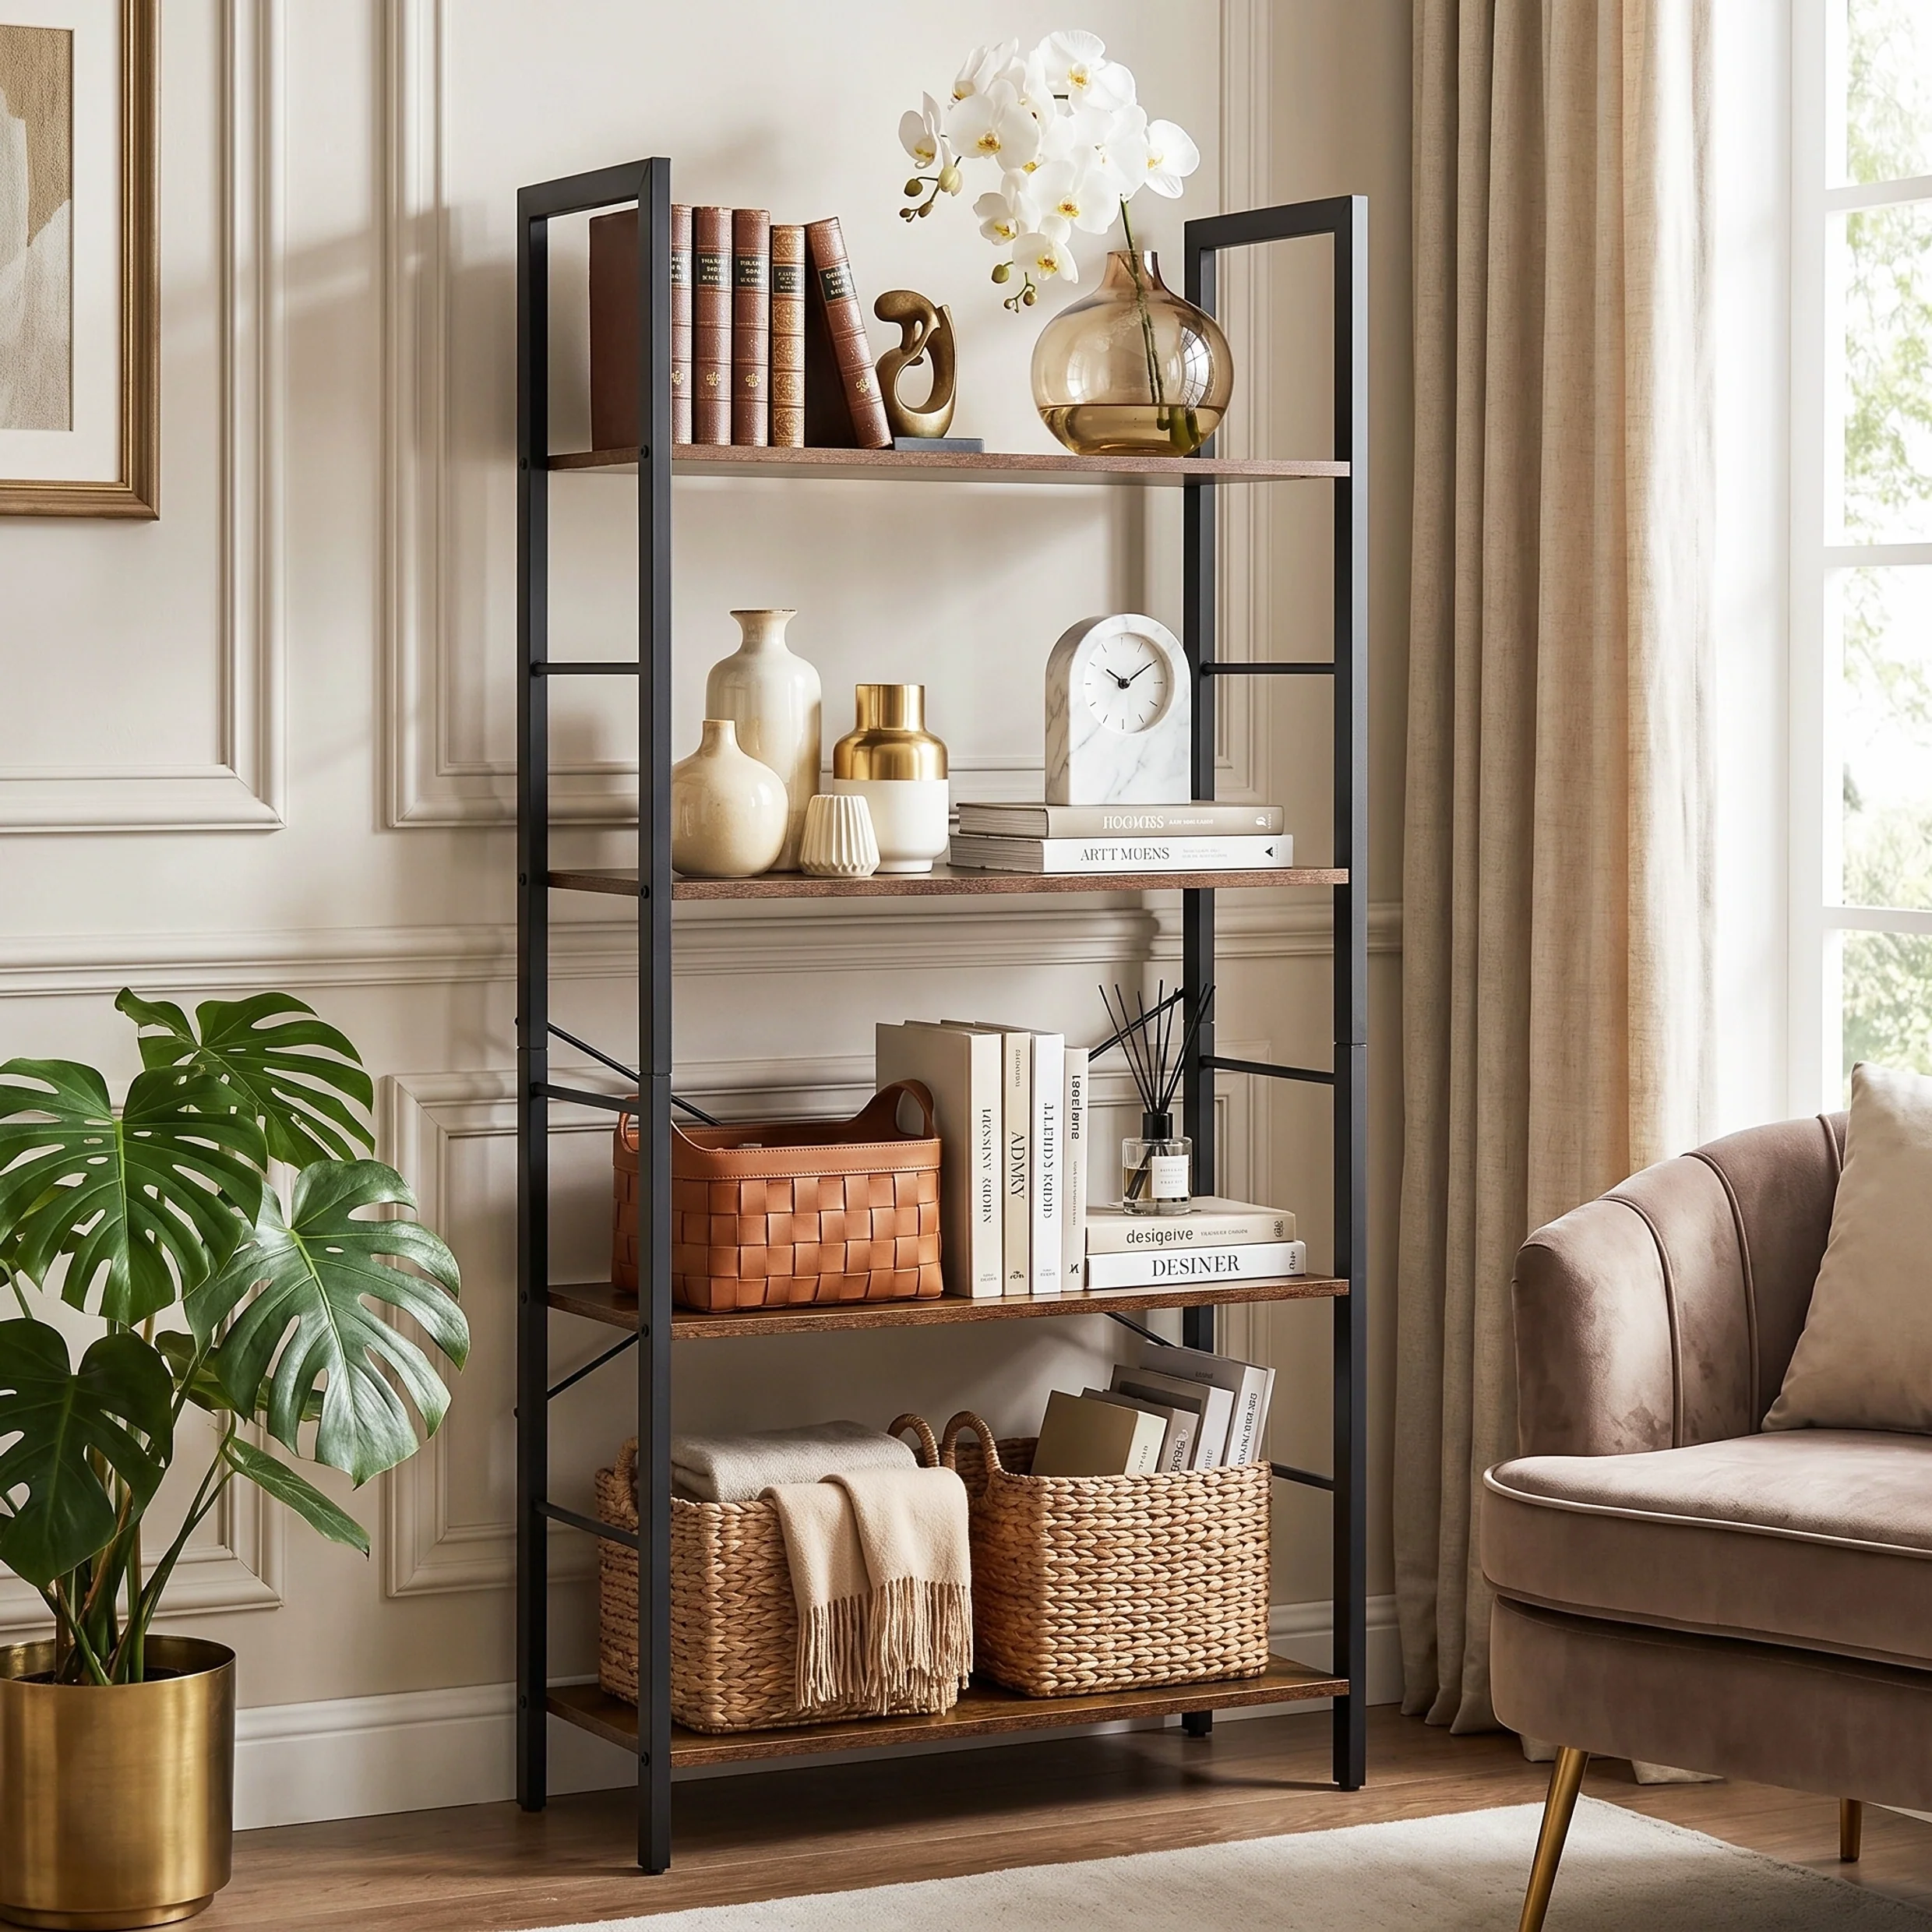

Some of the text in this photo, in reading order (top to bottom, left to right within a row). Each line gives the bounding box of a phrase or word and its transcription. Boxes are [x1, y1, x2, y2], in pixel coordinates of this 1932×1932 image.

[1080, 848, 1118, 861] ARTT
[1120, 847, 1170, 860] MOENS
[1126, 1228, 1193, 1246] desigeive
[1151, 1254, 1240, 1278] DESINER
